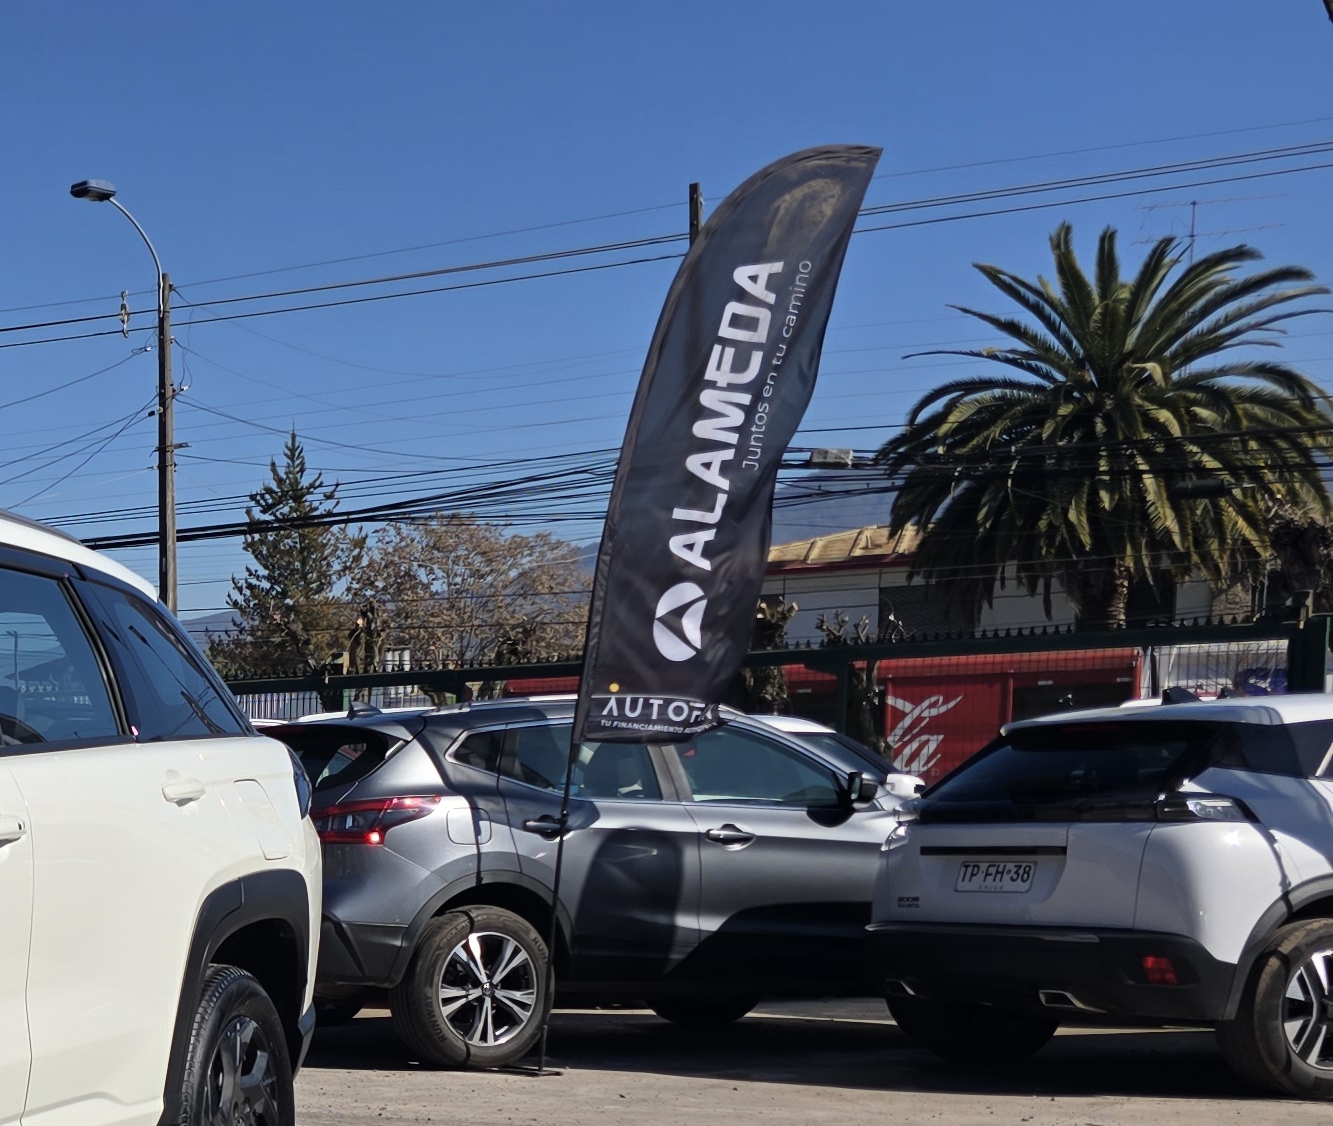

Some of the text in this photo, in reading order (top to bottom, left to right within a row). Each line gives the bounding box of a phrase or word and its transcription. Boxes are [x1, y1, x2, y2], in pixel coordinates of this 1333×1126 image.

[668, 260, 785, 572] ALAMEDA
[742, 260, 812, 471] Juntos en tu camino
